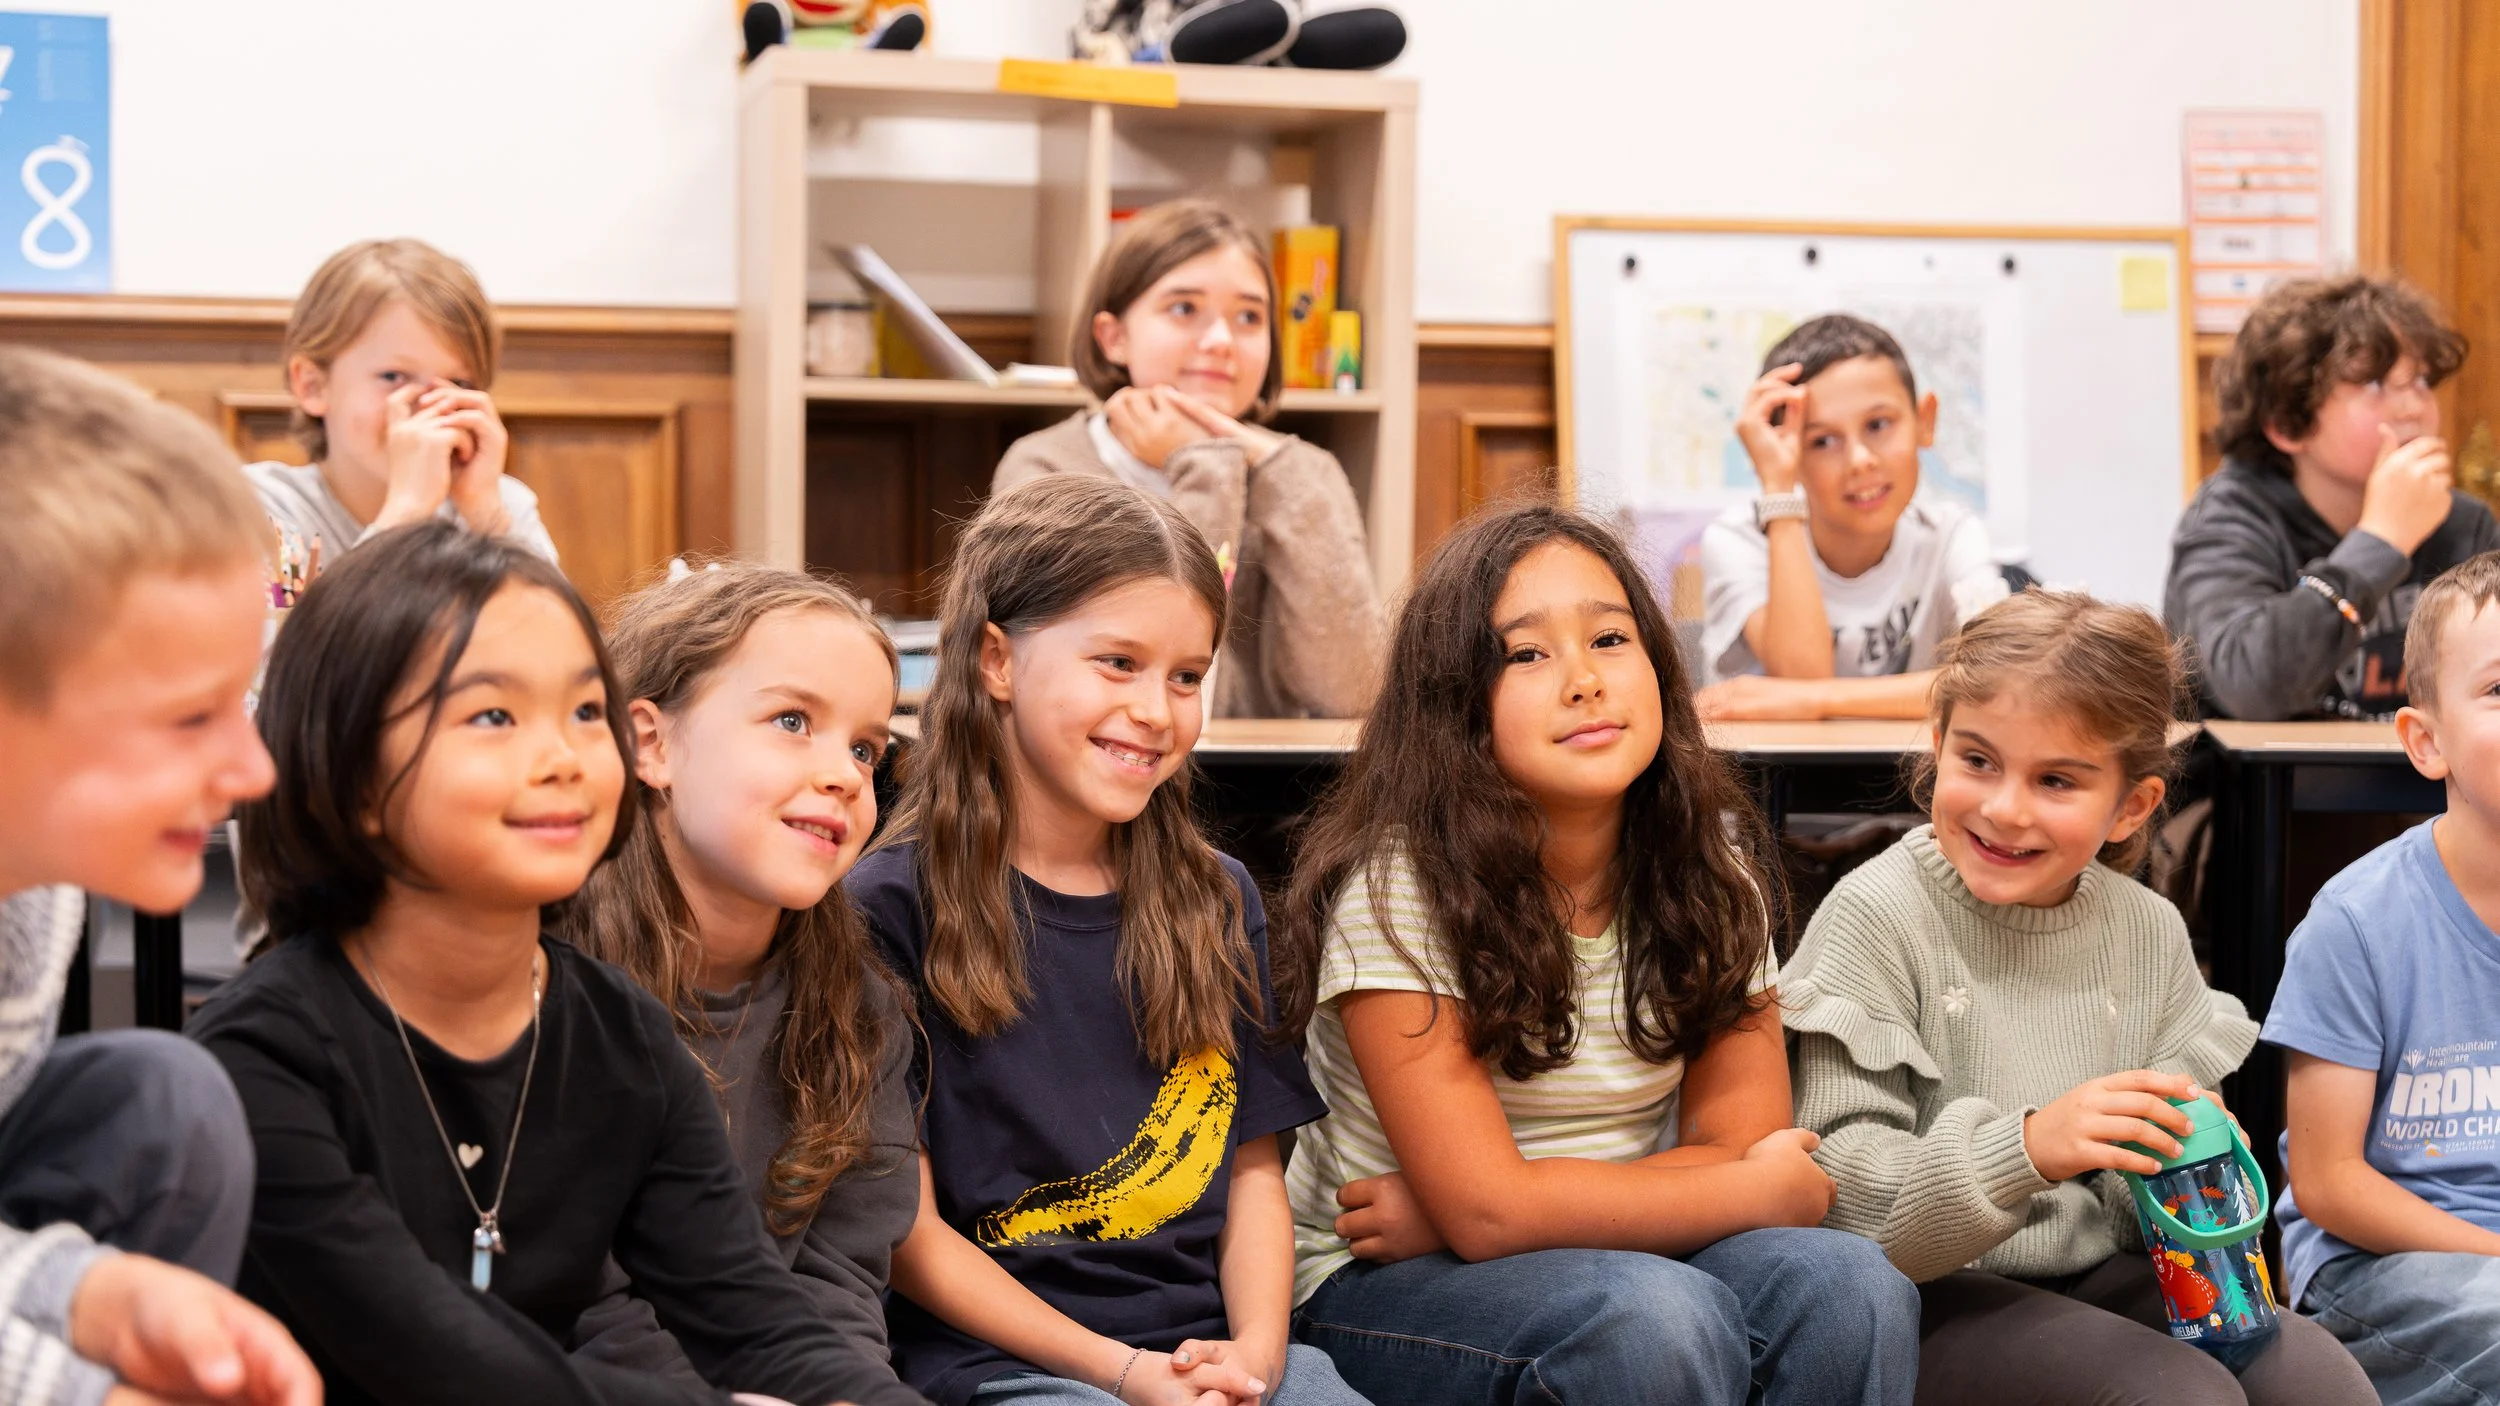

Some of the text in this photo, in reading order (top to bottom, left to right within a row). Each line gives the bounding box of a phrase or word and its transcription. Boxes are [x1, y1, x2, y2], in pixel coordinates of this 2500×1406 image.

[20, 138, 93, 270] 8
[2389, 1066, 2500, 1117] IRON
[2385, 1118, 2459, 1140] WORLD
[2170, 1323, 2202, 1338] MELBAK
